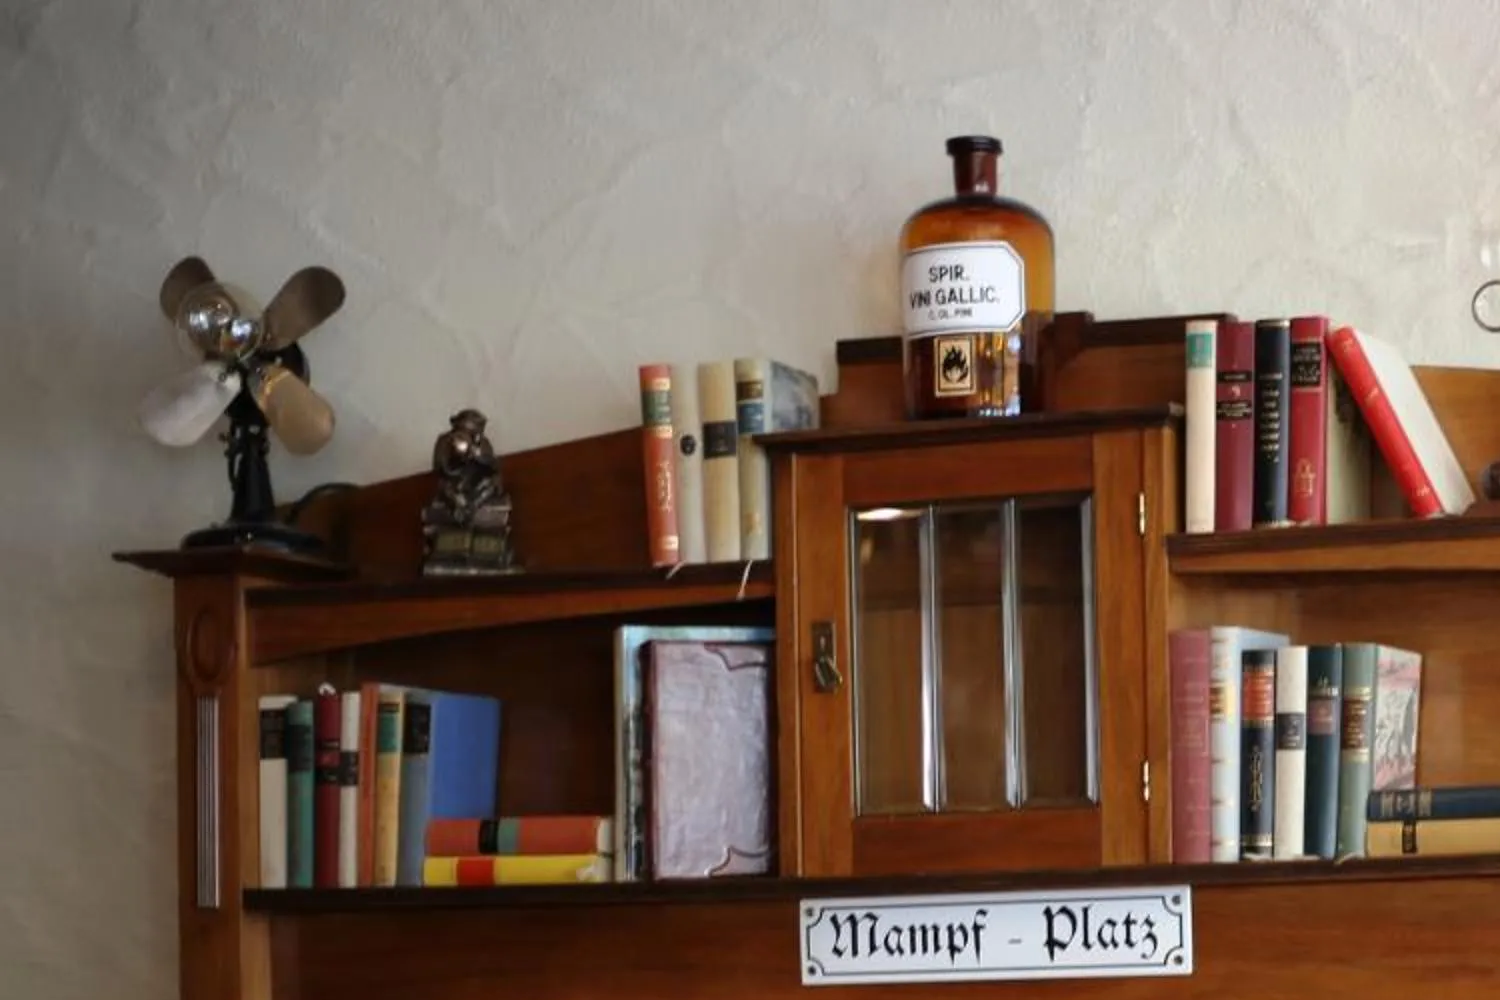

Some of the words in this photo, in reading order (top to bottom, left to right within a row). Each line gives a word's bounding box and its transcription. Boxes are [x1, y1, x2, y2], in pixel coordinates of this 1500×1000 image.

[928, 264, 970, 282] SPIR.
[935, 285, 1000, 305] GALLIC.
[829, 908, 989, 966] Mampf
[1043, 904, 1159, 962] Platz
